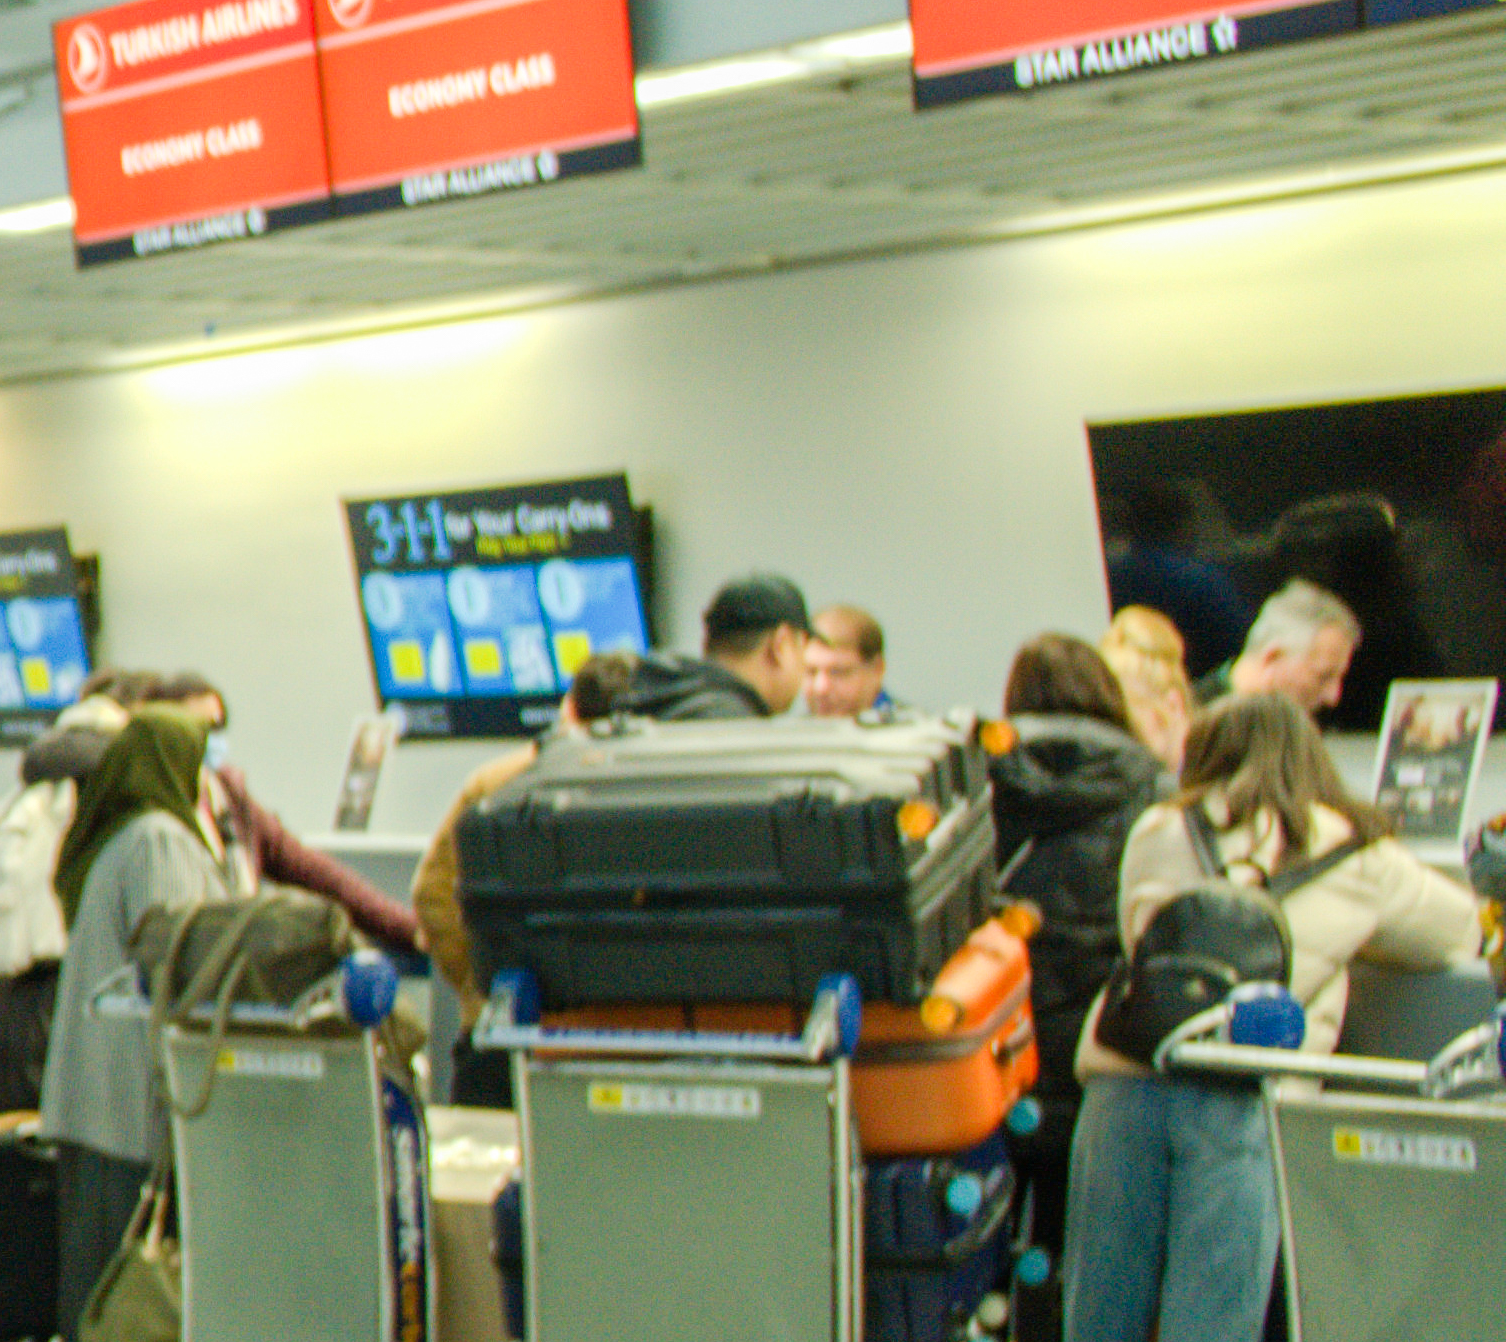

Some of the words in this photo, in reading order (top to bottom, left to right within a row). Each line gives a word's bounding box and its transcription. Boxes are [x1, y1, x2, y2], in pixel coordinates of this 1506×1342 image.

[109, 12, 200, 69] TURKISH
[1013, 43, 1079, 89] STAR
[1081, 20, 1208, 76] ALLIANCE
[387, 67, 487, 119] ECONOMY
[489, 51, 557, 97] CLASS
